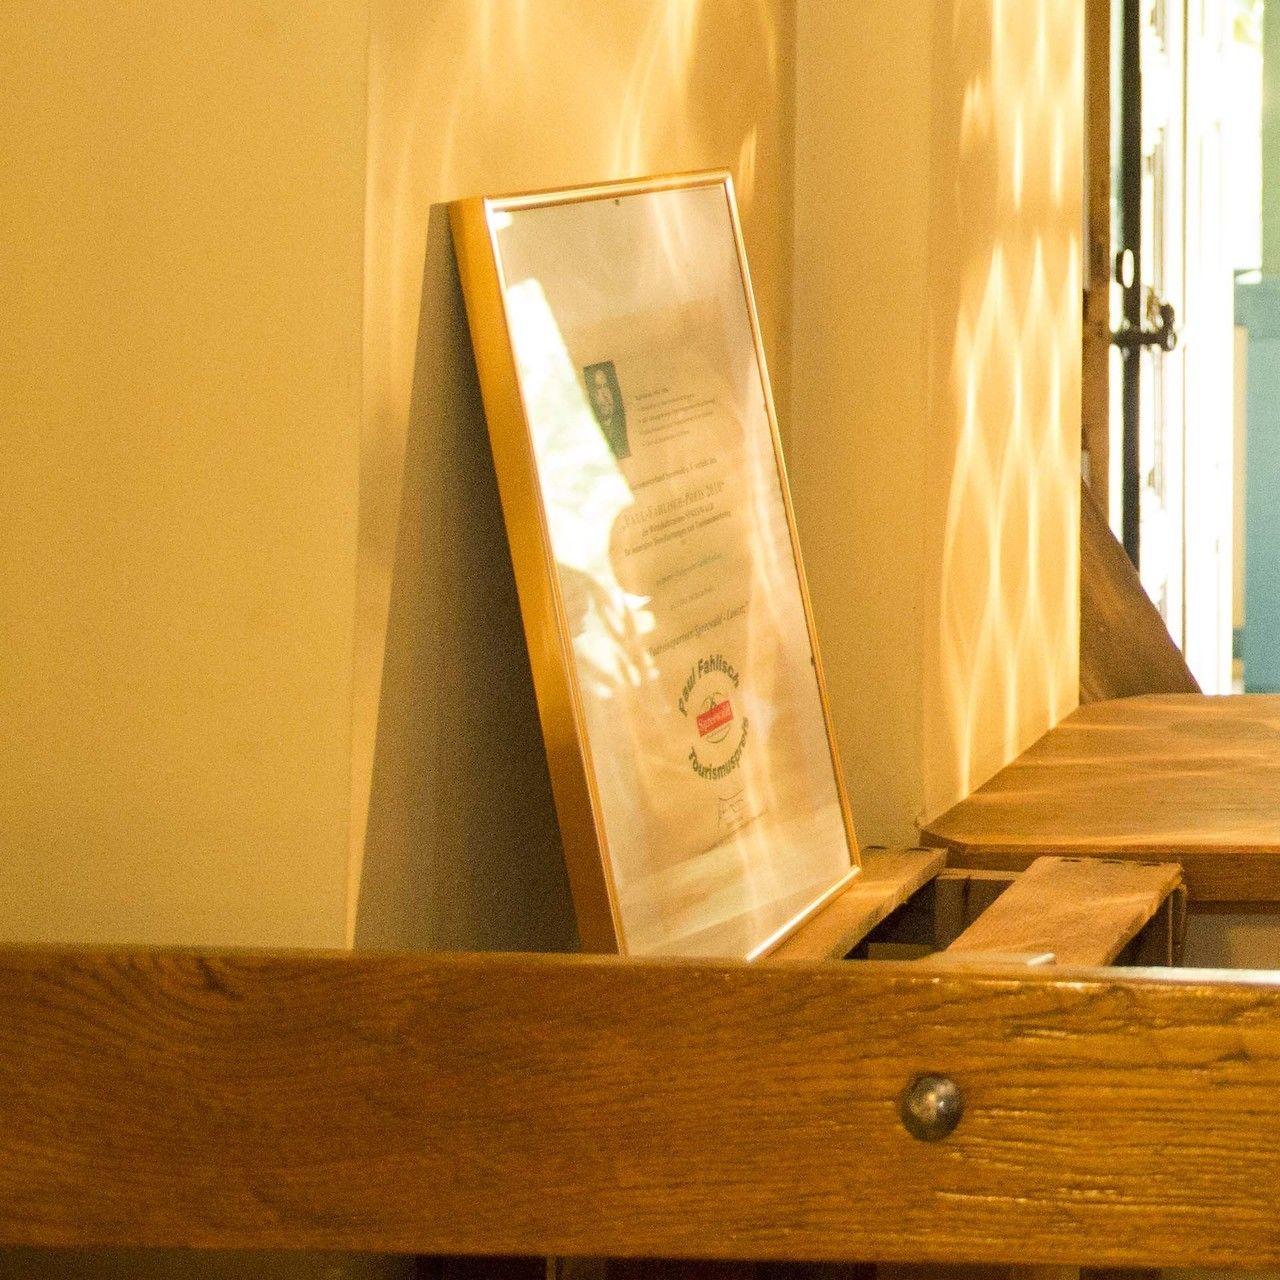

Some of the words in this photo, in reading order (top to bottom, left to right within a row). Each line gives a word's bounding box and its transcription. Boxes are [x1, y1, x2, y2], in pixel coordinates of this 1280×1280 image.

[678, 666, 697, 718] Paul
[697, 653, 740, 689] Fahlisch
[688, 716, 750, 781] Tourismuspreis
